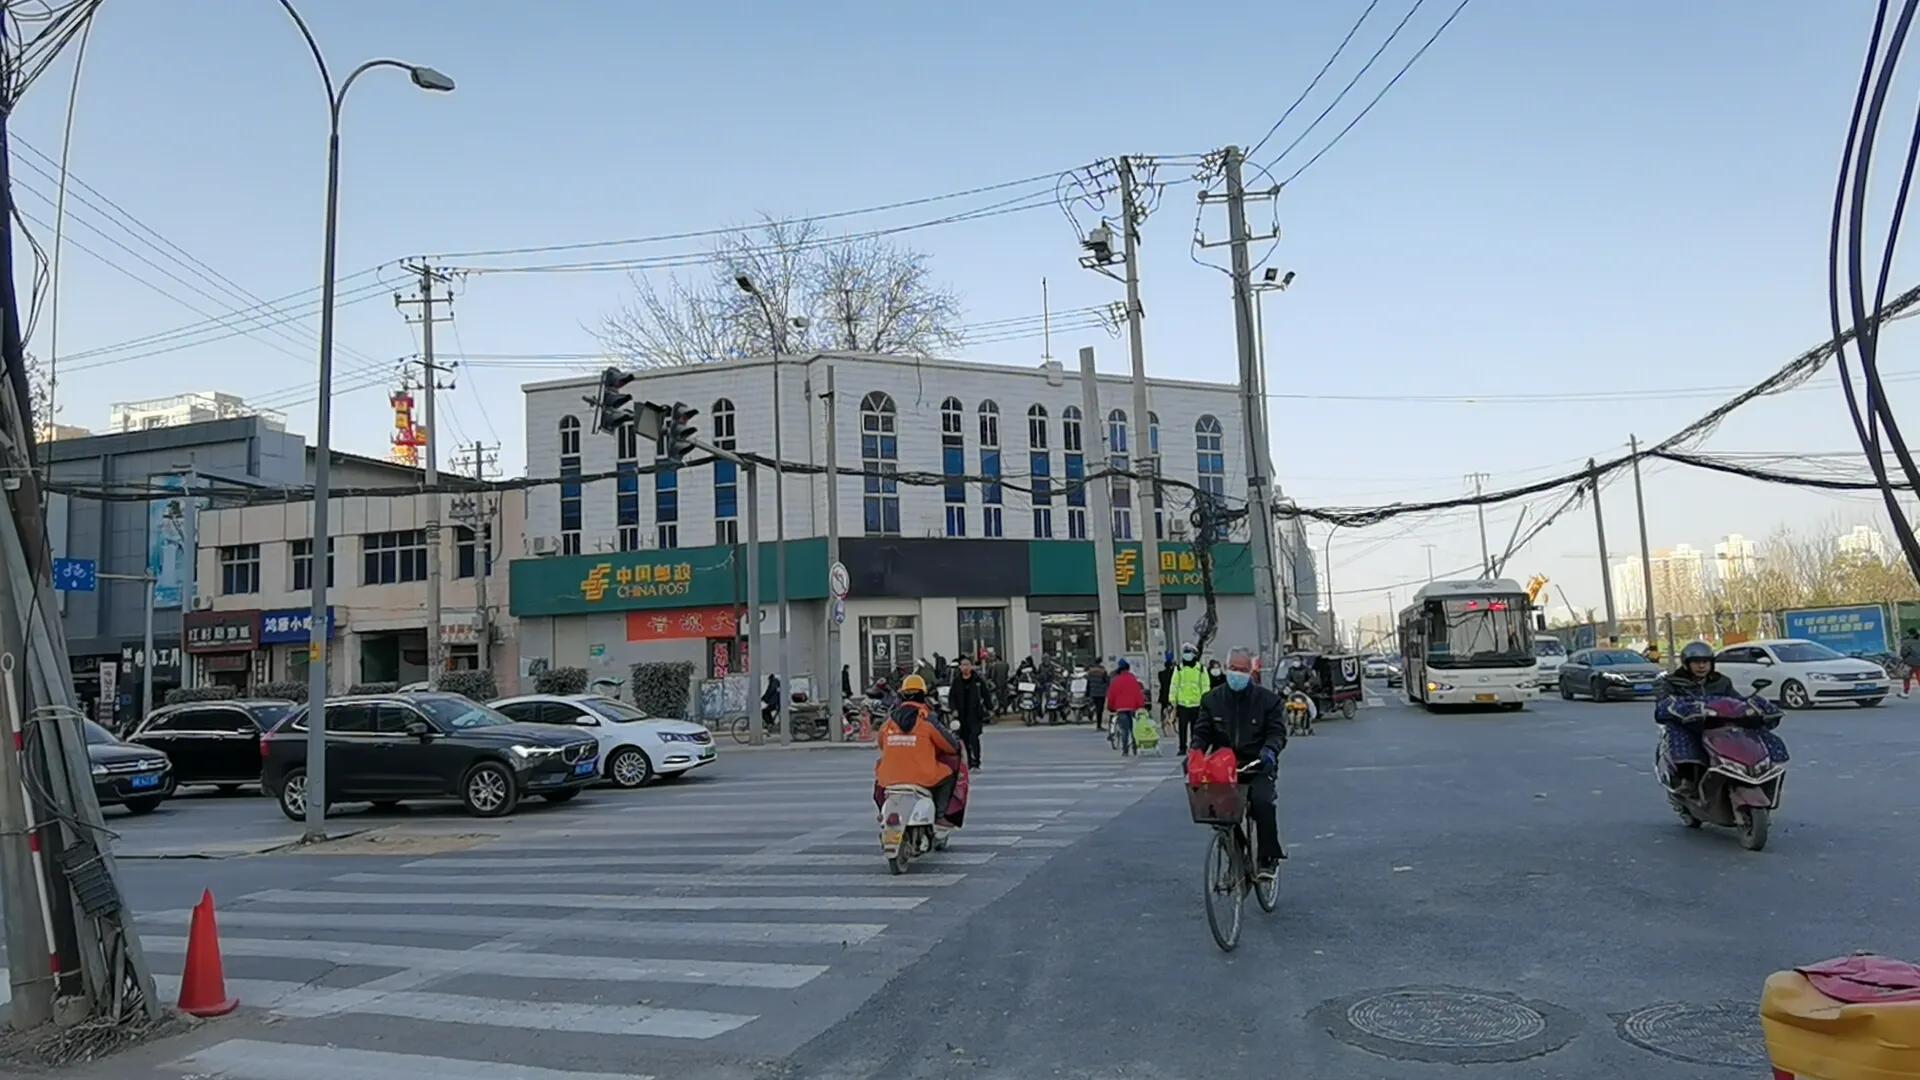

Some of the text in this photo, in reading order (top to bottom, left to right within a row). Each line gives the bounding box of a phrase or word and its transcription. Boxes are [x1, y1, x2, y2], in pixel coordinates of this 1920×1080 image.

[1160, 551, 1215, 571] 国邮
[616, 562, 691, 584] 中国邮政
[1183, 571, 1204, 585] POS
[616, 582, 691, 599] CHINA POST
